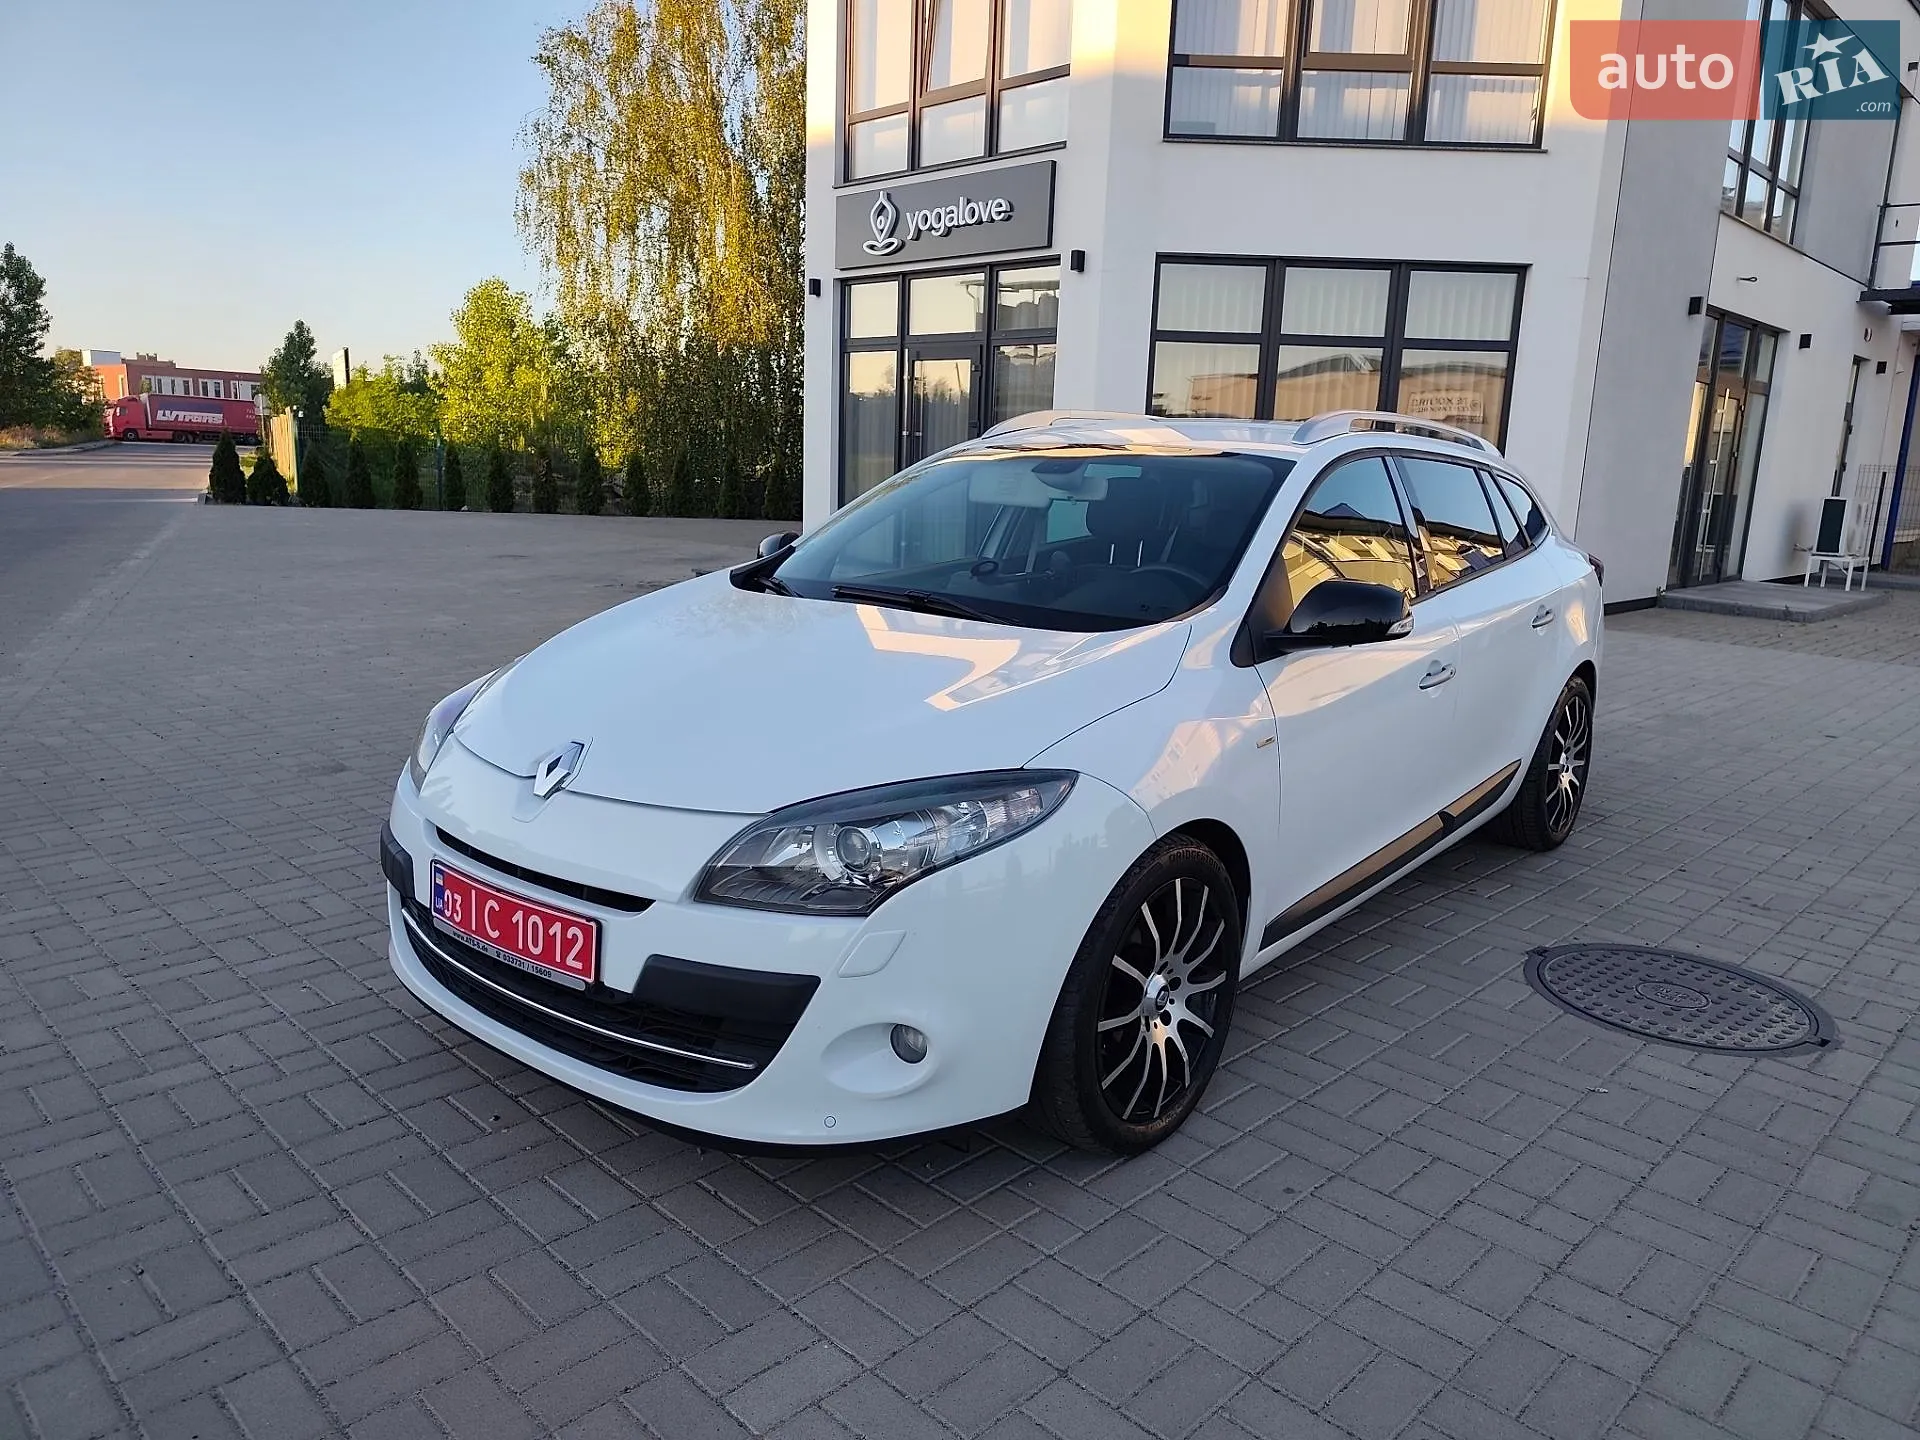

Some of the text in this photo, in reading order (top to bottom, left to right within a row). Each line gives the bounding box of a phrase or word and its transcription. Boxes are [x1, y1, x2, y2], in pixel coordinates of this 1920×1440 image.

[906, 196, 1011, 241] yogalove
[435, 895, 444, 910] UA
[443, 888, 462, 924] 03
[511, 910, 584, 970] 1012
